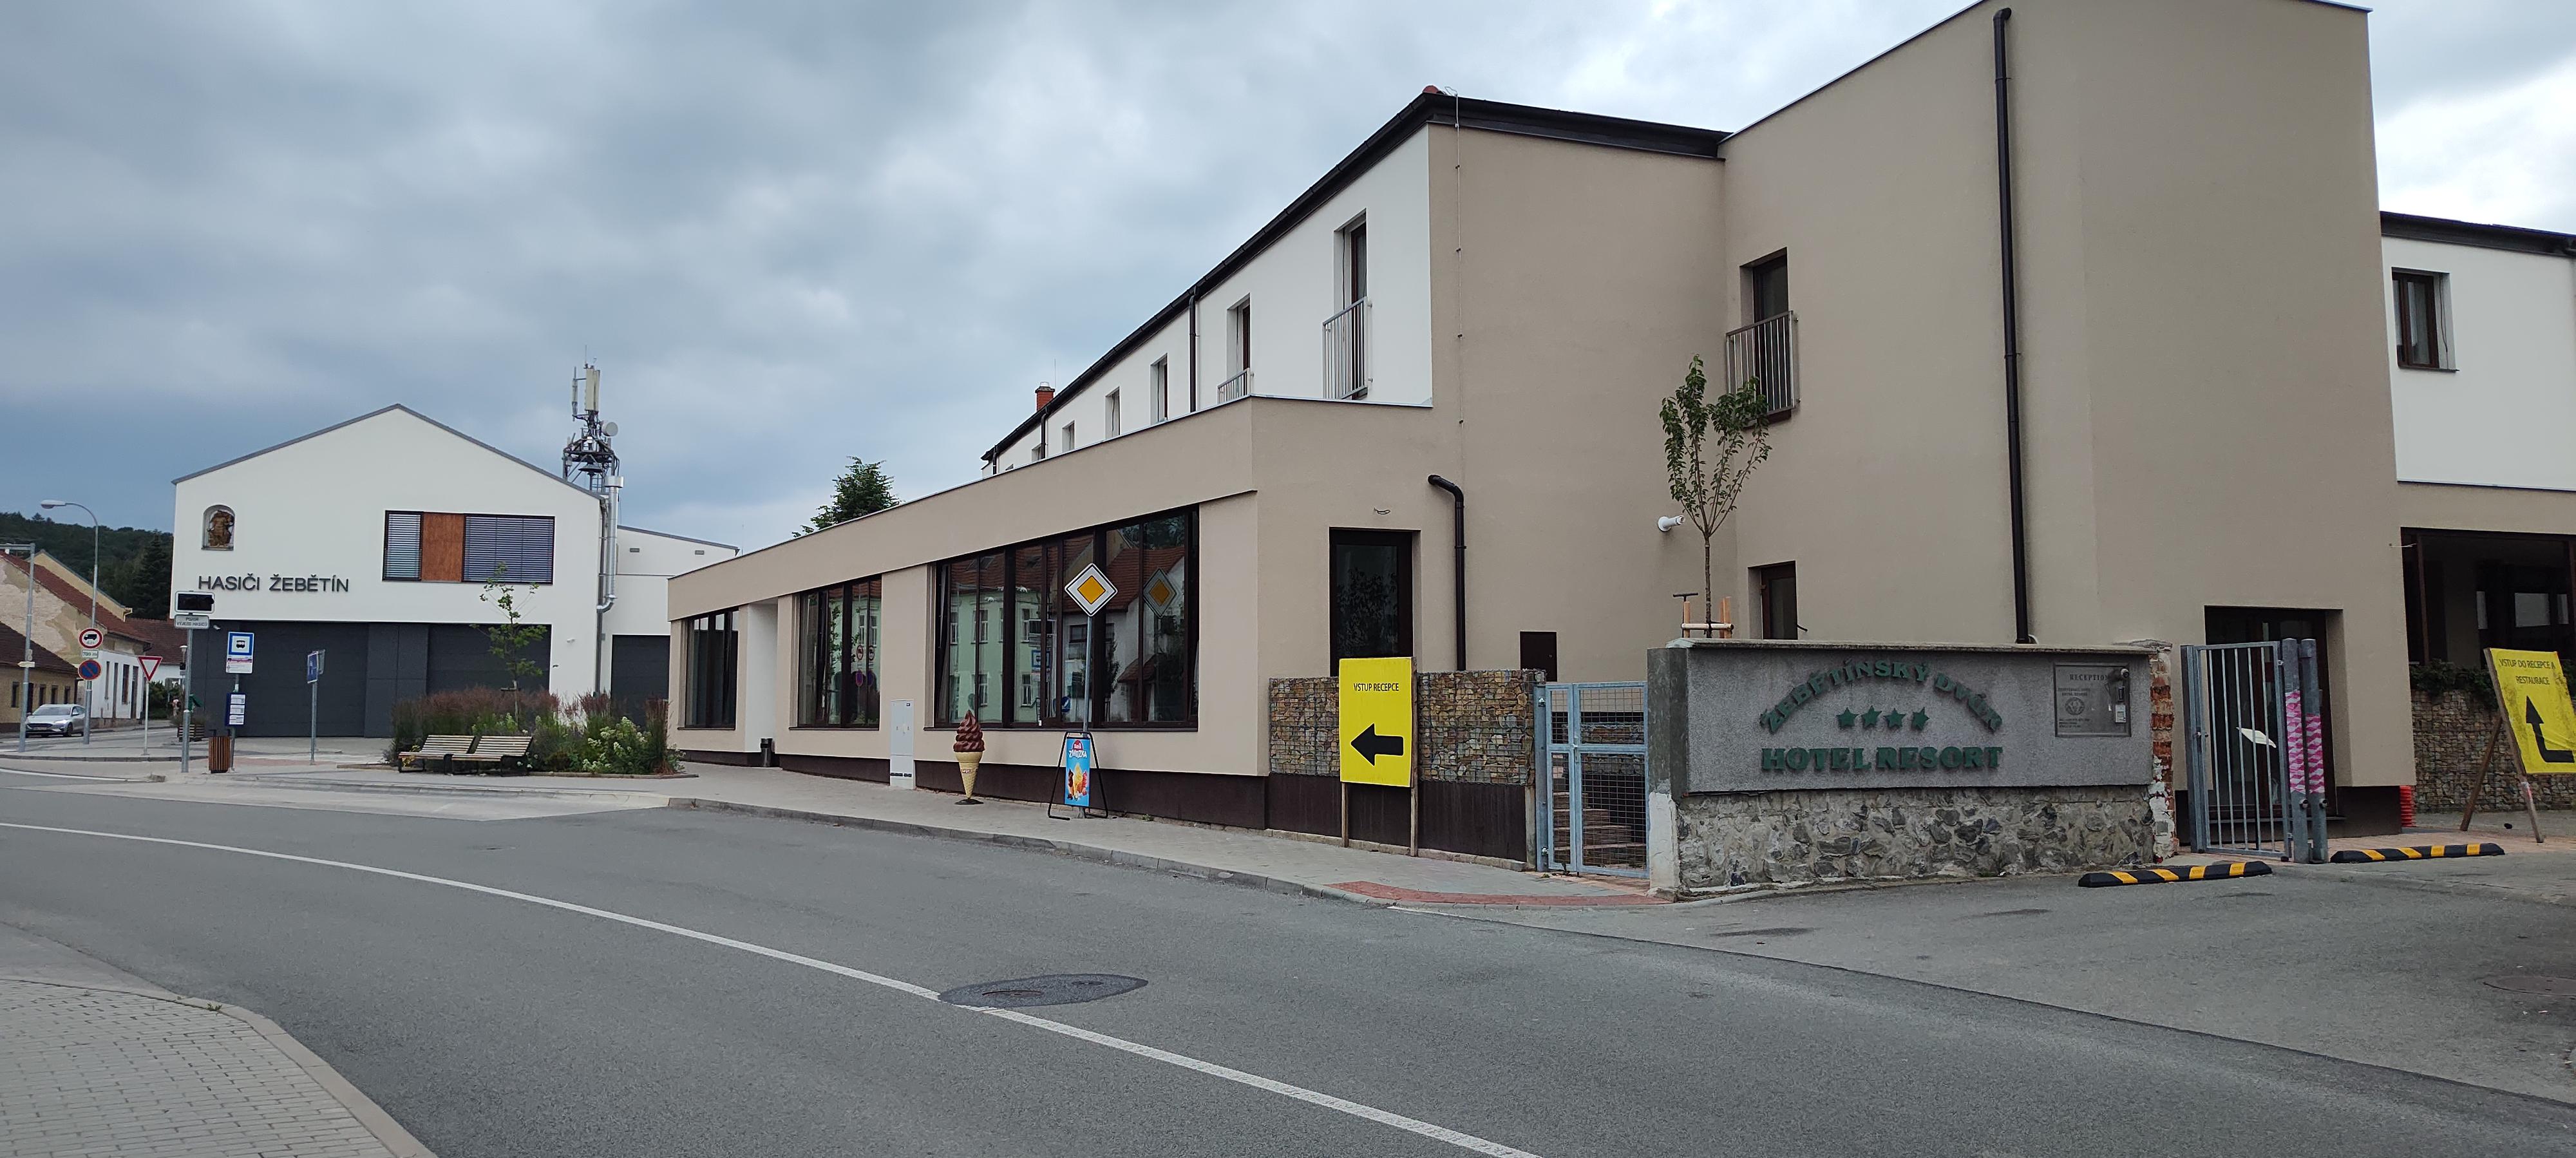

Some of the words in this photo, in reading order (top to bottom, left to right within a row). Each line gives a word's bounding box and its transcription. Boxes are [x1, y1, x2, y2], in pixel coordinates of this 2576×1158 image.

[198, 573, 260, 591] HASIČI
[269, 574, 349, 593] ŽEBĚTÍN
[2499, 659, 2517, 667] VSTUP
[2517, 660, 2527, 668] DO
[2526, 660, 2550, 669] RECEPCE
[2515, 676, 2550, 685] RESTAURACE
[1353, 683, 1372, 692] VSTUP
[1374, 683, 1399, 692] RECEPCE
[1761, 747, 1871, 770] HOTEL
[1876, 746, 2003, 770] RESORT
